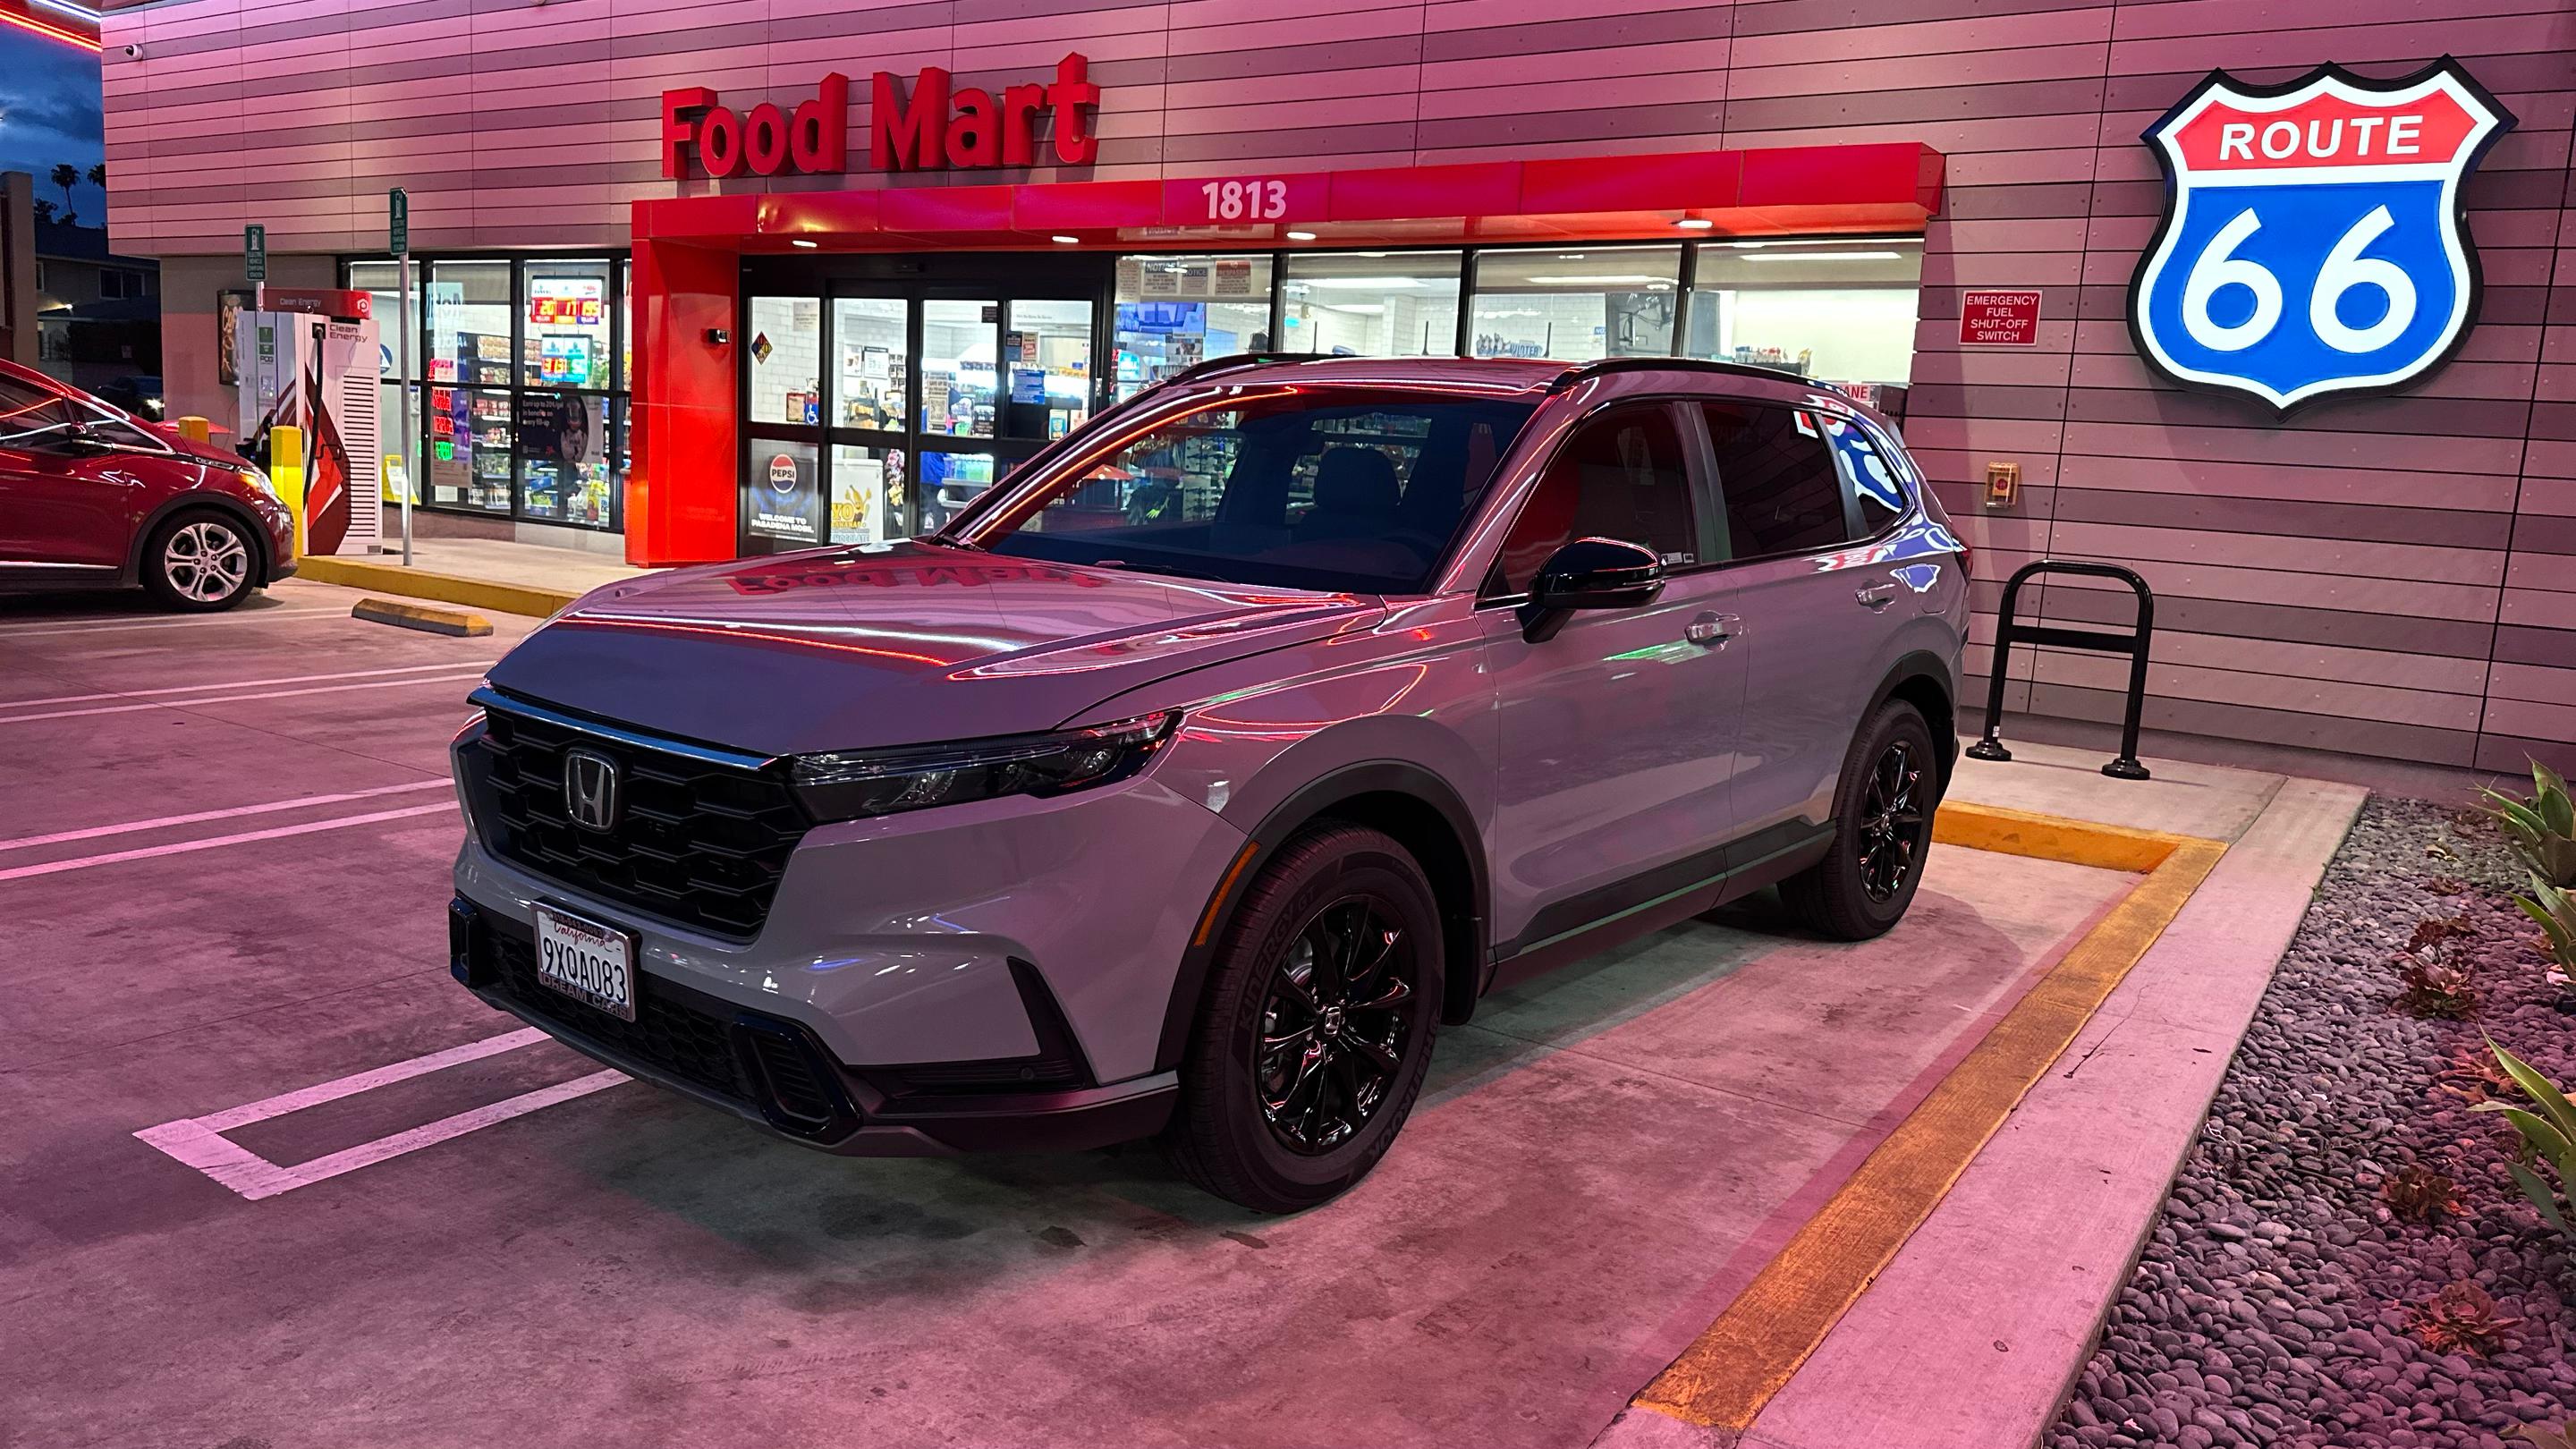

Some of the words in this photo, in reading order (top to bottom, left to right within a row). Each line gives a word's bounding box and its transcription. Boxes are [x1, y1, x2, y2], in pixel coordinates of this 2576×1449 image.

[662, 72, 849, 179] Food
[872, 51, 1100, 172] Mart
[2219, 114, 2423, 161] ROUTE
[1202, 180, 1287, 220] 1813
[2182, 204, 2417, 354] 66
[279, 297, 296, 306] Clean
[299, 298, 322, 308] Energy
[1966, 295, 2037, 306] EMERGENCY
[1987, 308, 2013, 317] FUEL
[330, 324, 358, 334] Clean
[1970, 319, 2029, 328] SHUT-OFF
[330, 333, 369, 343] Energy
[1977, 331, 2020, 341] SWITCH
[1844, 386, 1868, 398] ANE
[772, 469, 795, 479] PEPSI
[751, 519, 791, 531] PASADENA
[758, 513, 795, 524] WELCOME
[795, 517, 808, 525] TO
[544, 936, 627, 1003] 9XQA083
[543, 974, 588, 1002] DREAM
